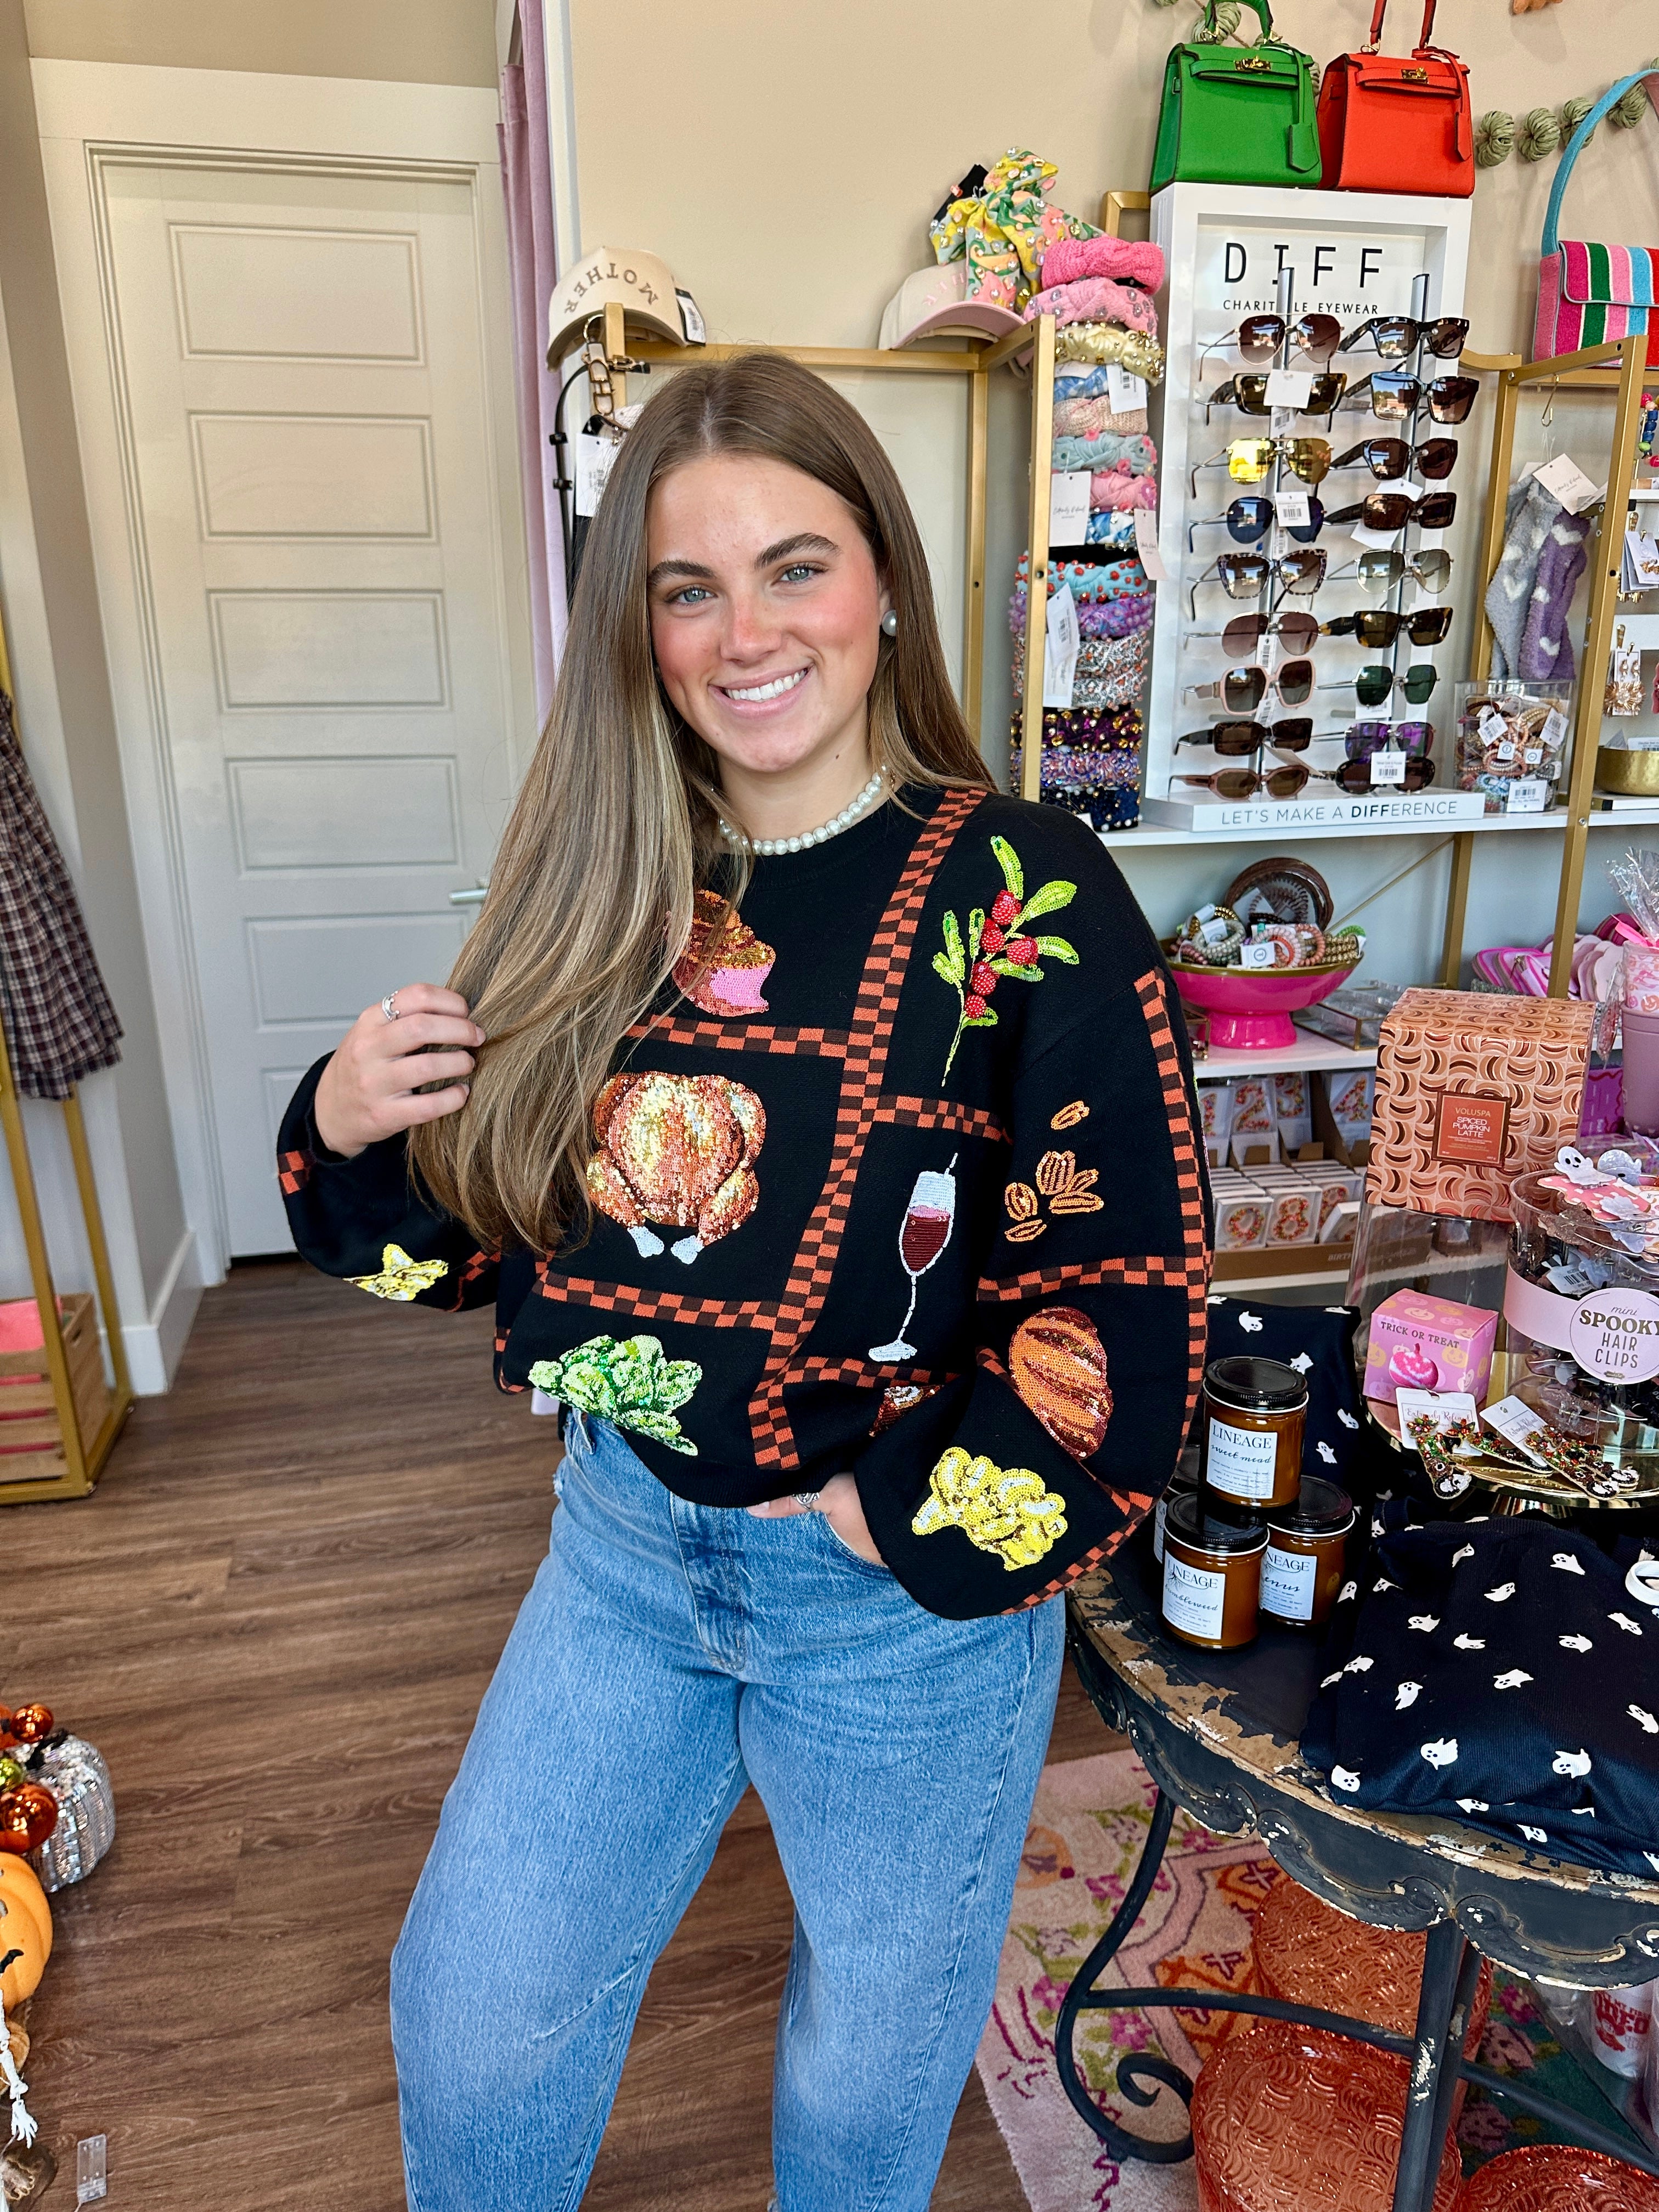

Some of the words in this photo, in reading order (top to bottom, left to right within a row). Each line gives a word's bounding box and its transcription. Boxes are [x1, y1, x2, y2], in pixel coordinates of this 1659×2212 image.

[1224, 242, 1383, 288] DIFF
[564, 263, 658, 314] MOTHER
[1223, 300, 1308, 312] CHARITLE
[1318, 302, 1378, 314] EYEWEAR
[1222, 809, 1268, 825] LET'S
[1276, 806, 1325, 822] MAKE
[1331, 806, 1344, 819] A
[1351, 800, 1458, 818] DIFFERENCE
[1455, 1107, 1491, 1118] VOLUSPA
[1457, 1116, 1488, 1126] SPICED
[1452, 1122, 1491, 1132] PUMPKIN
[1457, 1129, 1484, 1138] LATTE
[1611, 1306, 1639, 1316] mini
[1381, 1321, 1408, 1335] TRICK
[1412, 1330, 1425, 1340] OR
[1428, 1334, 1459, 1348] TREAT
[1601, 1332, 1638, 1351] HAIR
[1595, 1348, 1638, 1368] CLIPS
[1212, 1424, 1272, 1448] LINEAGE
[1211, 1444, 1239, 1459] sweet
[1267, 1551, 1311, 1572] NEAGE
[1167, 1559, 1219, 1589] LINEAGE
[1265, 1576, 1301, 1592] enus
